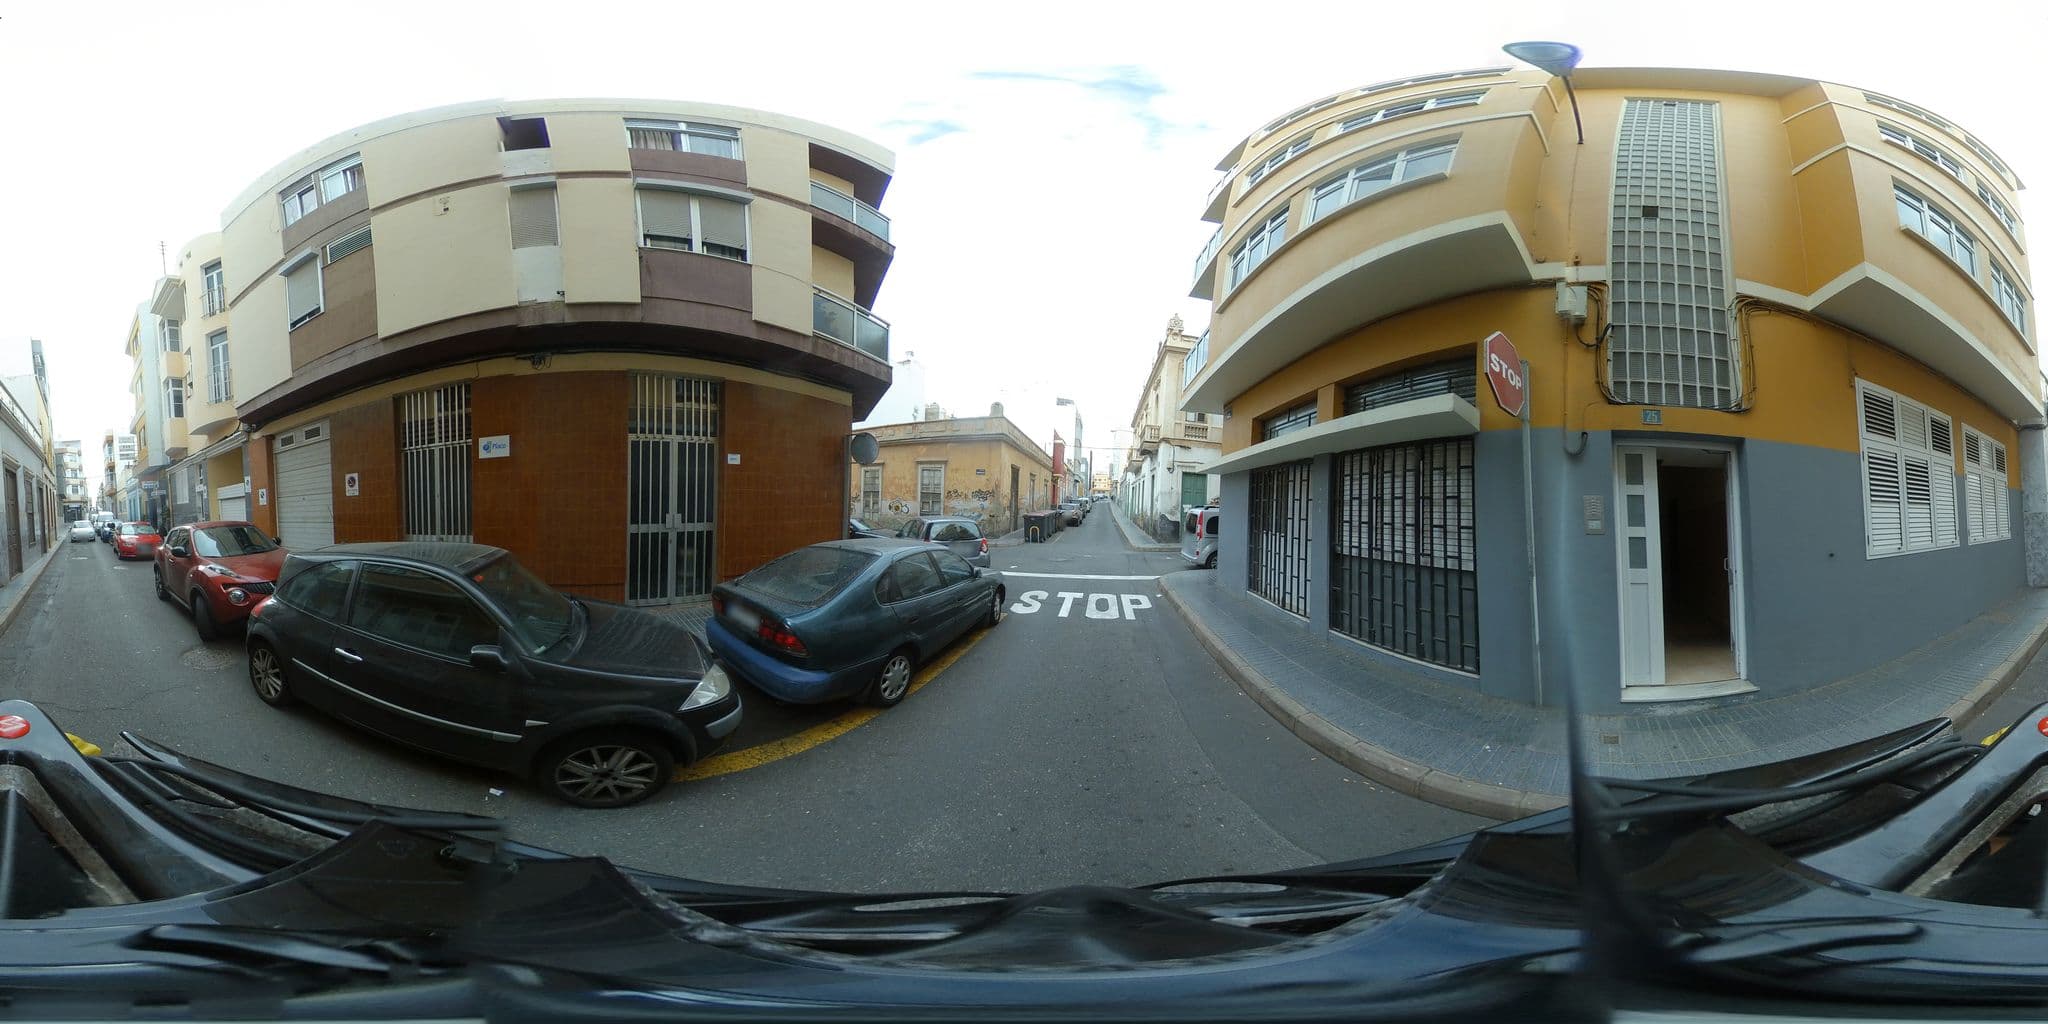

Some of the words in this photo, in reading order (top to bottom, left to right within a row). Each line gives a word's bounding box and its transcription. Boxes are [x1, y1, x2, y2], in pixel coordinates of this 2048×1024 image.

[1490, 353, 1521, 389] STOP
[1646, 410, 1658, 422] 25
[1009, 590, 1153, 620] STOP
